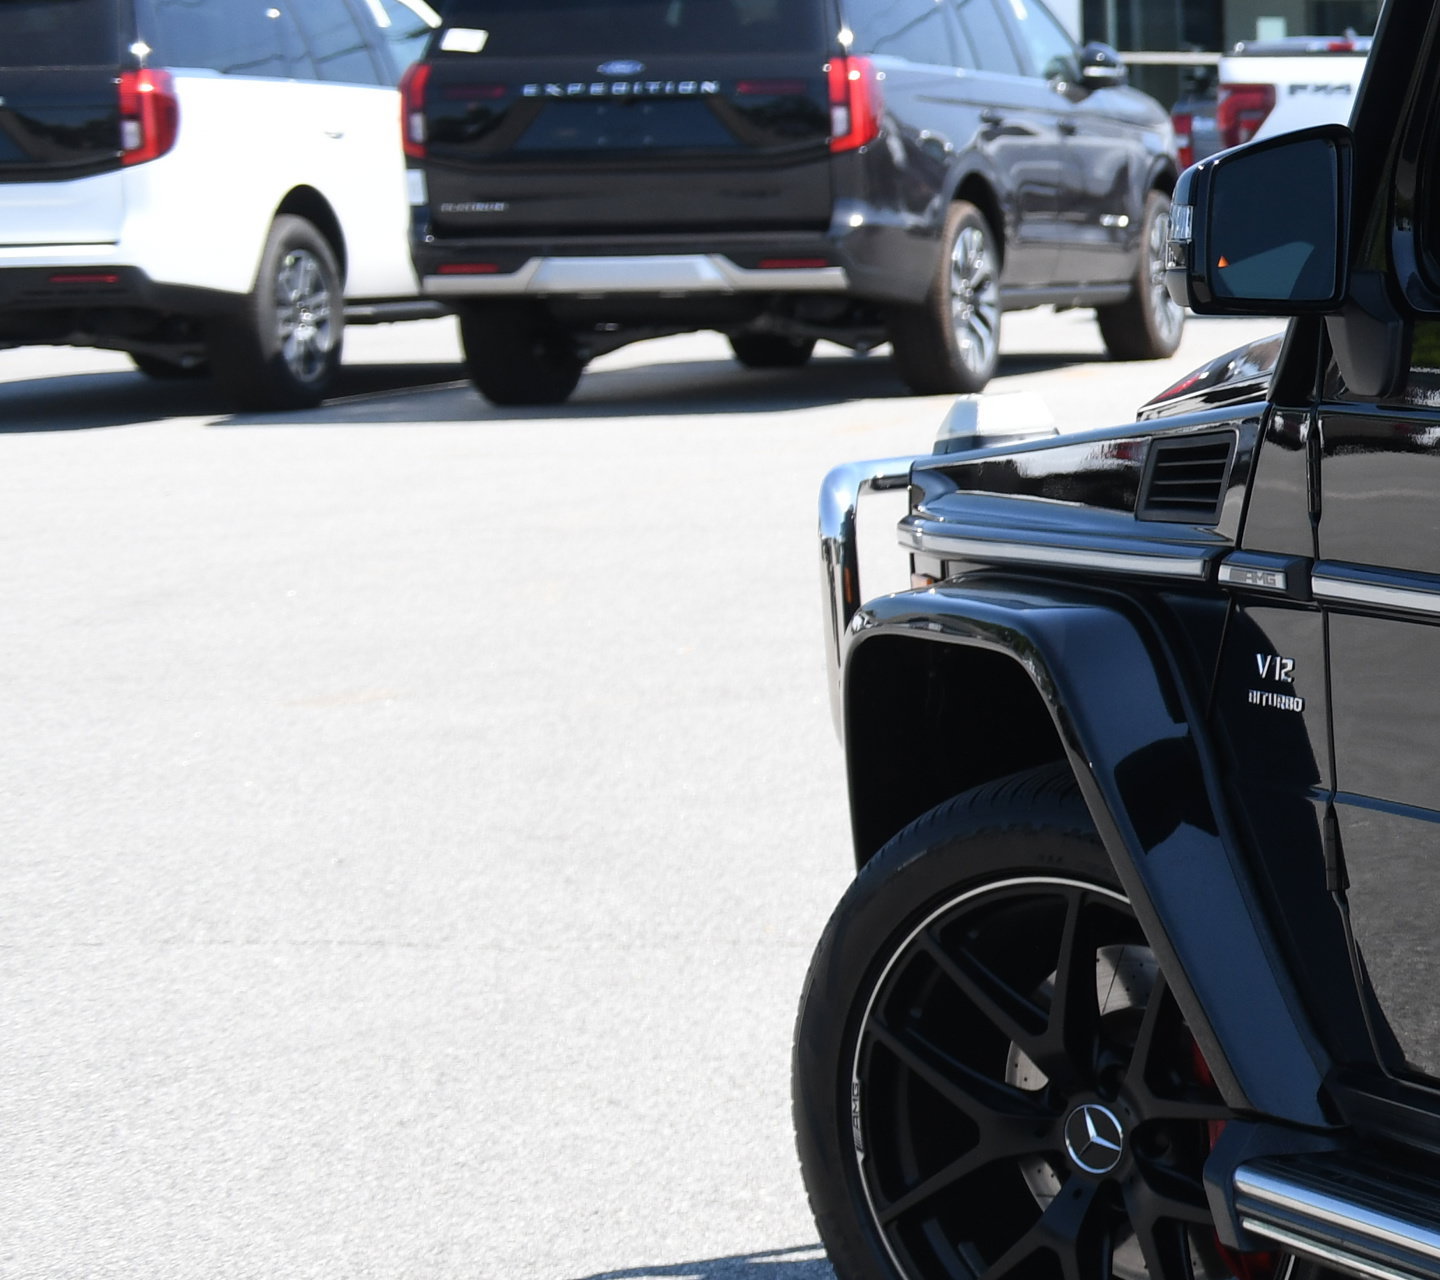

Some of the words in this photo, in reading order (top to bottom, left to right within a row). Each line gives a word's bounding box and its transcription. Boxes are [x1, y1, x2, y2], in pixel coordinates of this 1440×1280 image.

[522, 81, 720, 97] EXPEDITION
[1288, 83, 1352, 96] FX4
[1256, 653, 1295, 683] V12
[1248, 688, 1303, 712] BITURBO
